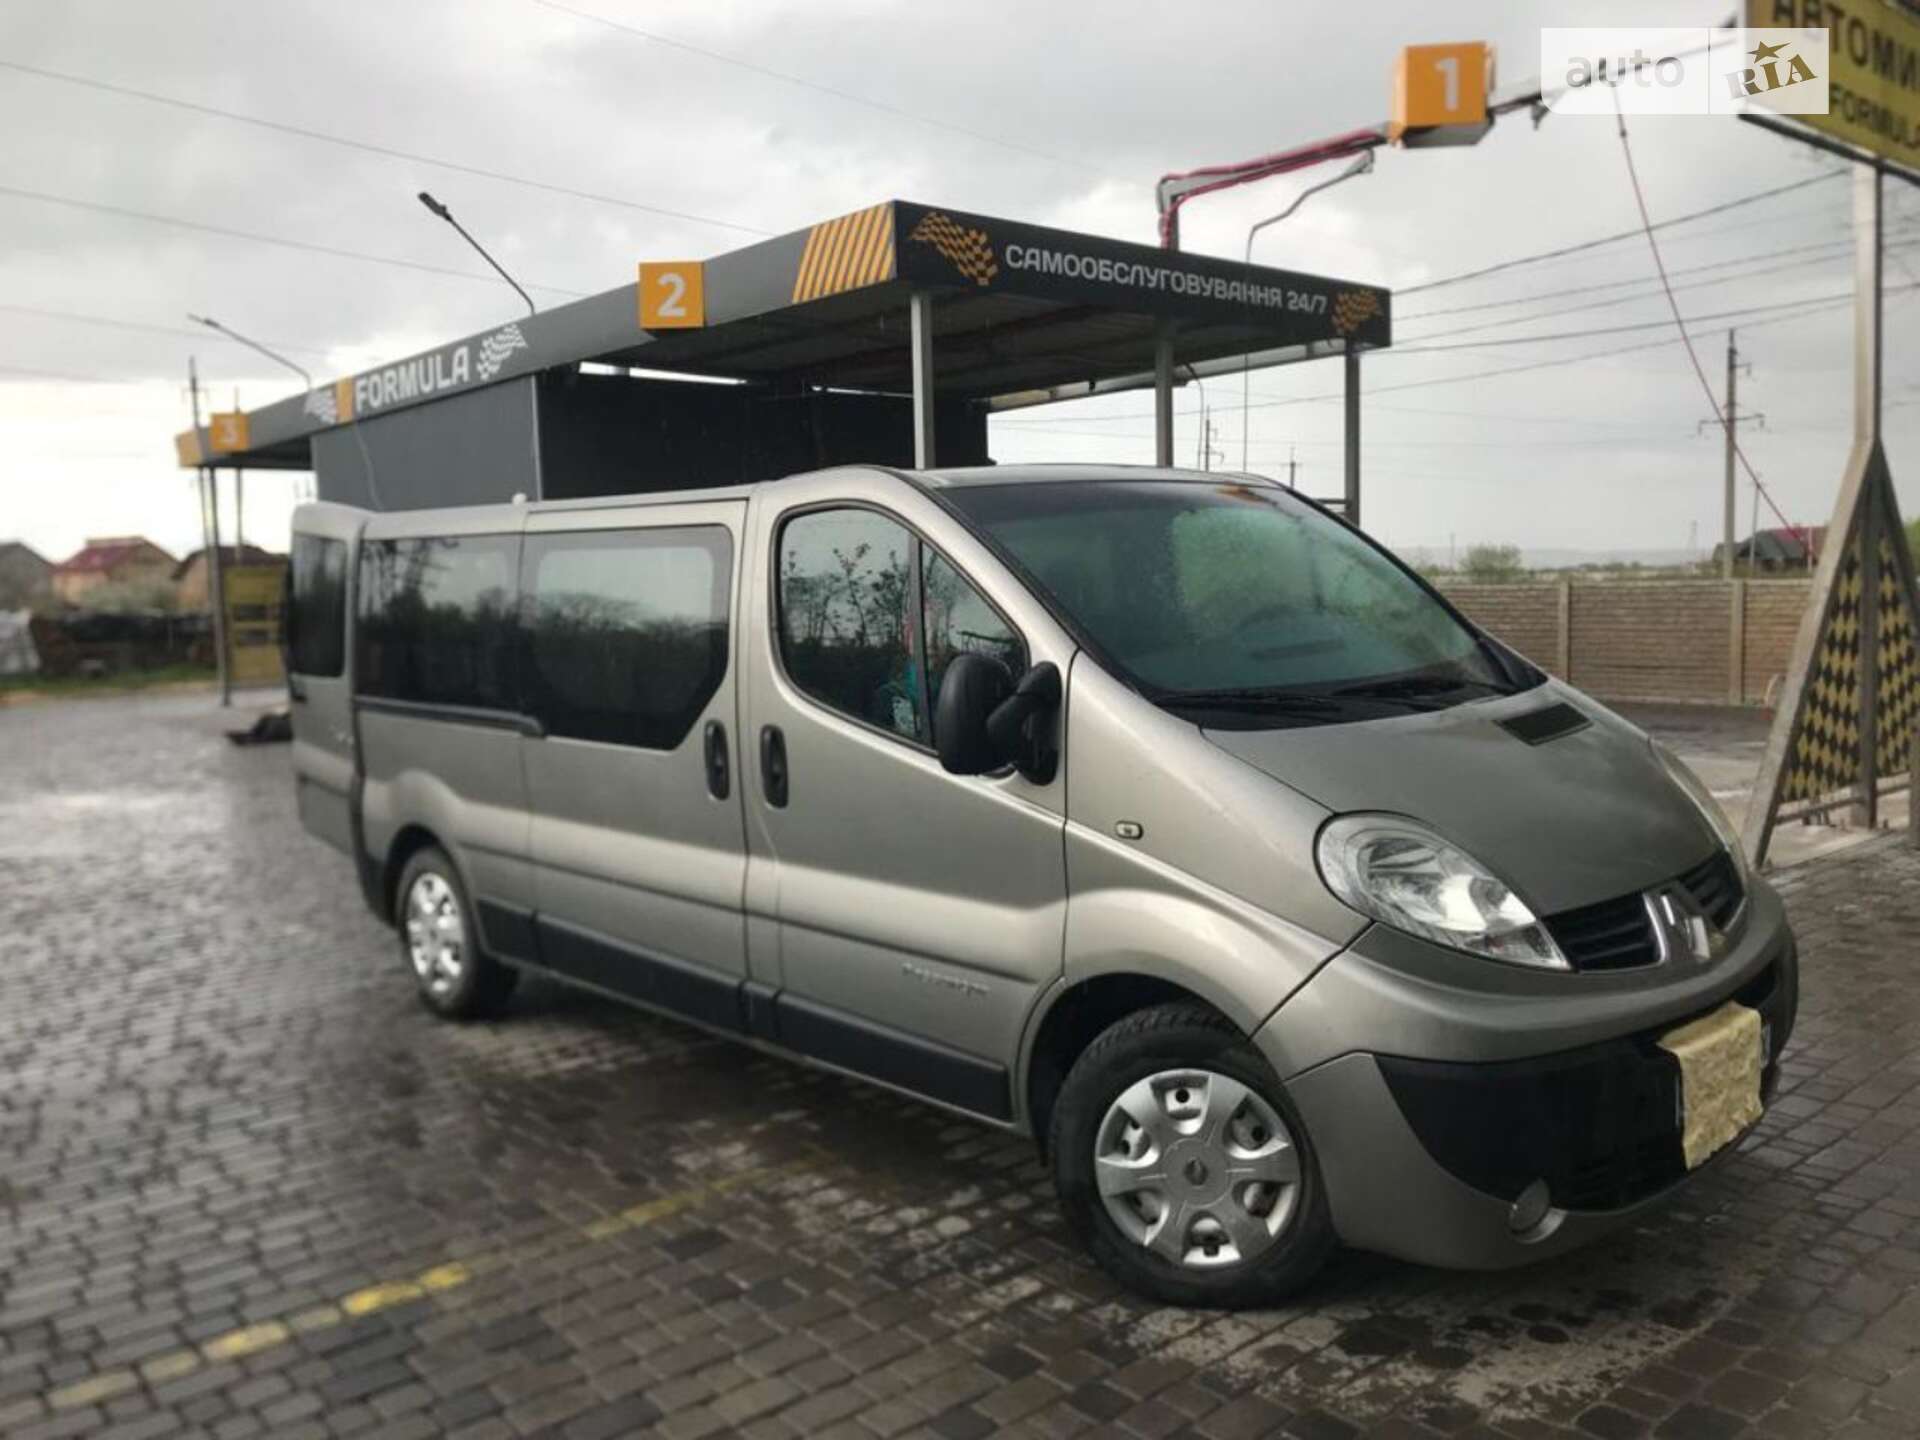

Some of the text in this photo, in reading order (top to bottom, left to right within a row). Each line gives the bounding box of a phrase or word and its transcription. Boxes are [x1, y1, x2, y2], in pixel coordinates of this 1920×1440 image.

[1435, 58, 1459, 112] 1
[1829, 82, 1920, 149] FORMUL
[657, 272, 687, 317] 2
[1005, 244, 1328, 315] САМООБСЛУГОВУВАННЯ 24/7
[355, 346, 470, 413] FORMULA
